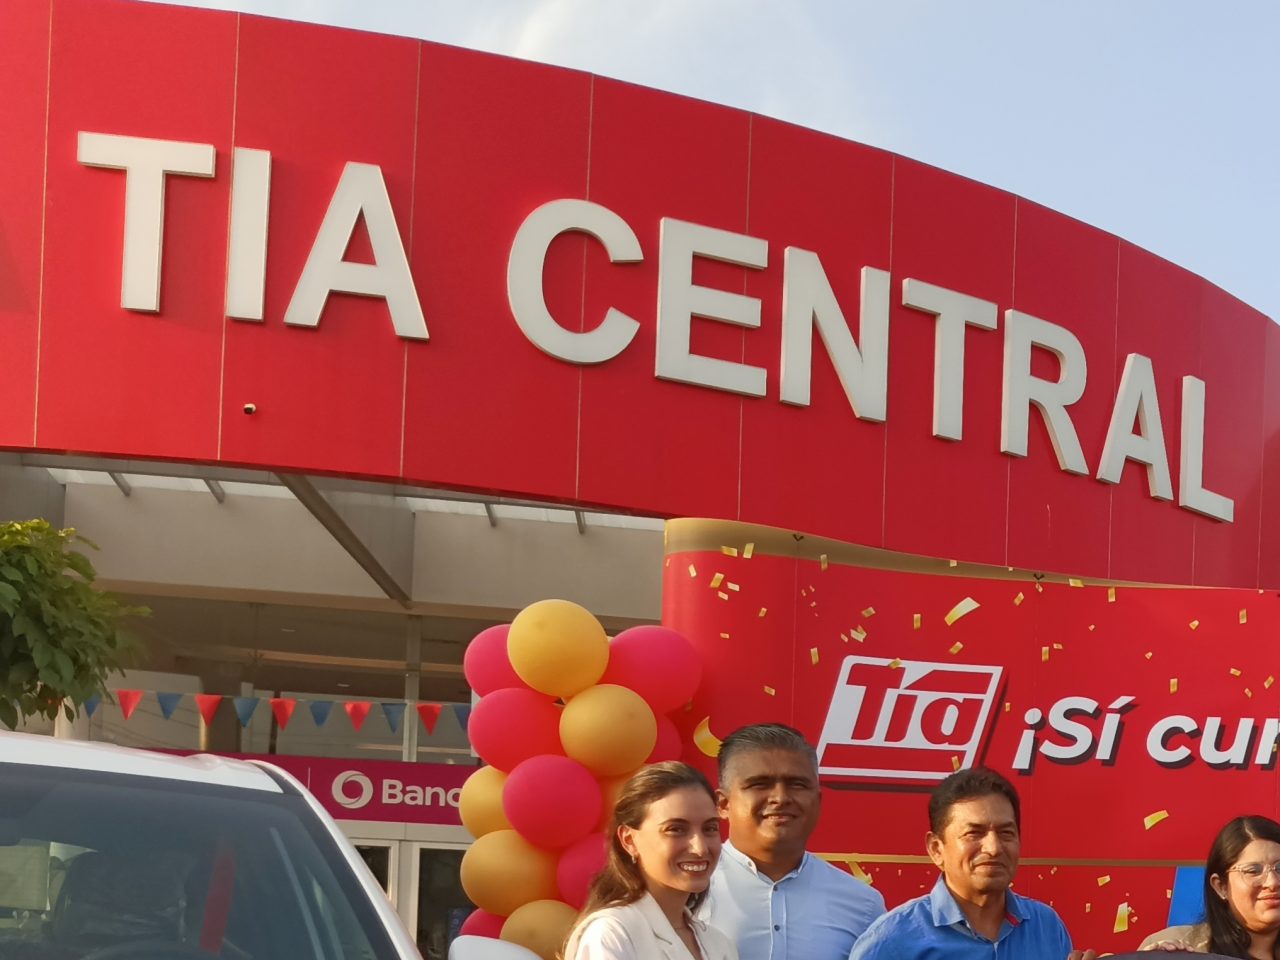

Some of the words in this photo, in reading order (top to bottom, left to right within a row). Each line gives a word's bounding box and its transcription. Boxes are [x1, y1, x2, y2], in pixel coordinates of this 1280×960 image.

[76, 130, 430, 342] TIA
[506, 197, 1235, 523] CENTRAL
[1011, 695, 1137, 770] ¡Sí
